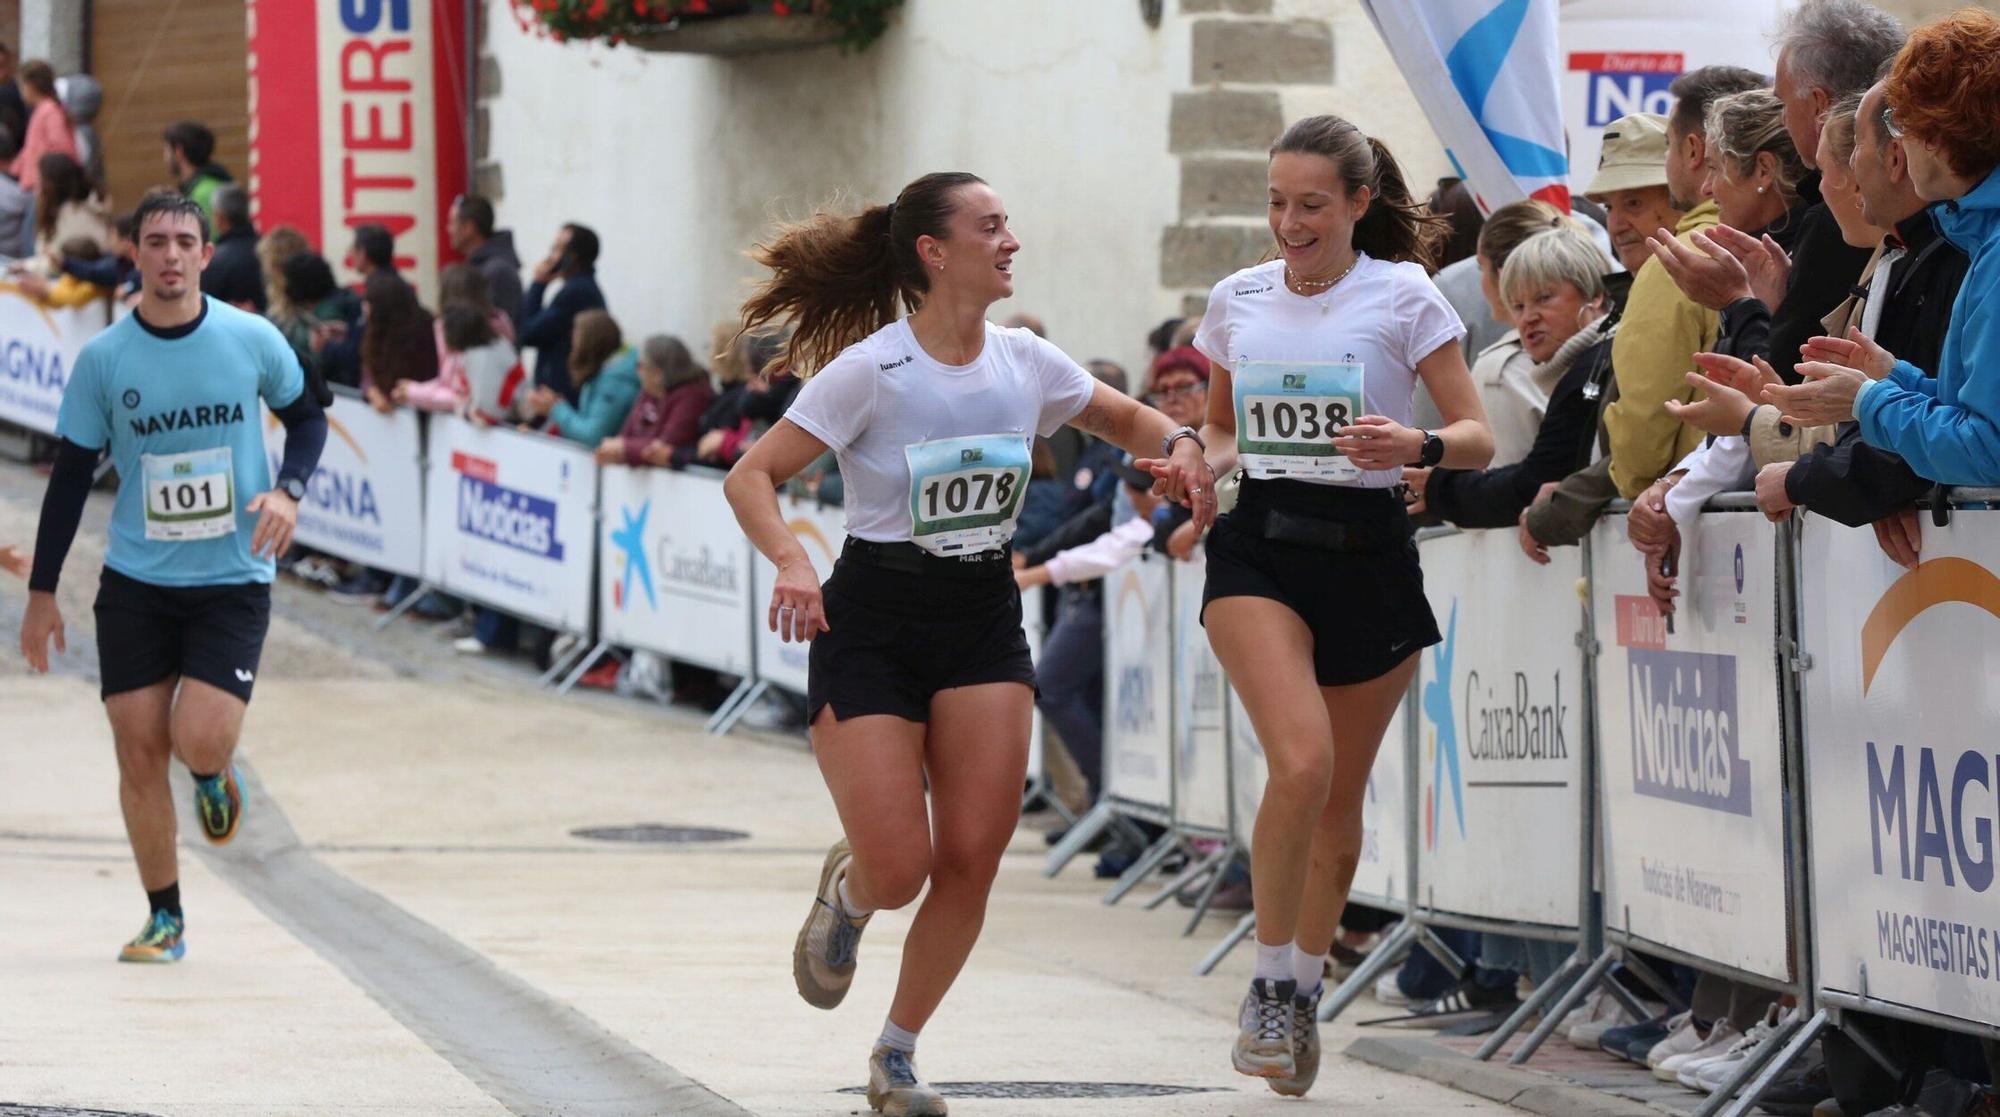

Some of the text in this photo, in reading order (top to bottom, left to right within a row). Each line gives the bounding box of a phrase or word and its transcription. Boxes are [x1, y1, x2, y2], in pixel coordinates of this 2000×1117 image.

[342, 0, 417, 293] NTERS
[130, 403, 244, 437] NAVARRA
[1250, 402, 1350, 439] 1038
[160, 481, 212, 511] 101
[925, 472, 1015, 516] 1078
[1466, 669, 1568, 761] CaixaBank
[1632, 663, 1732, 798] Noticias
[1866, 741, 2000, 893] MAG
[1876, 909, 1990, 980] MAGNESITAS
